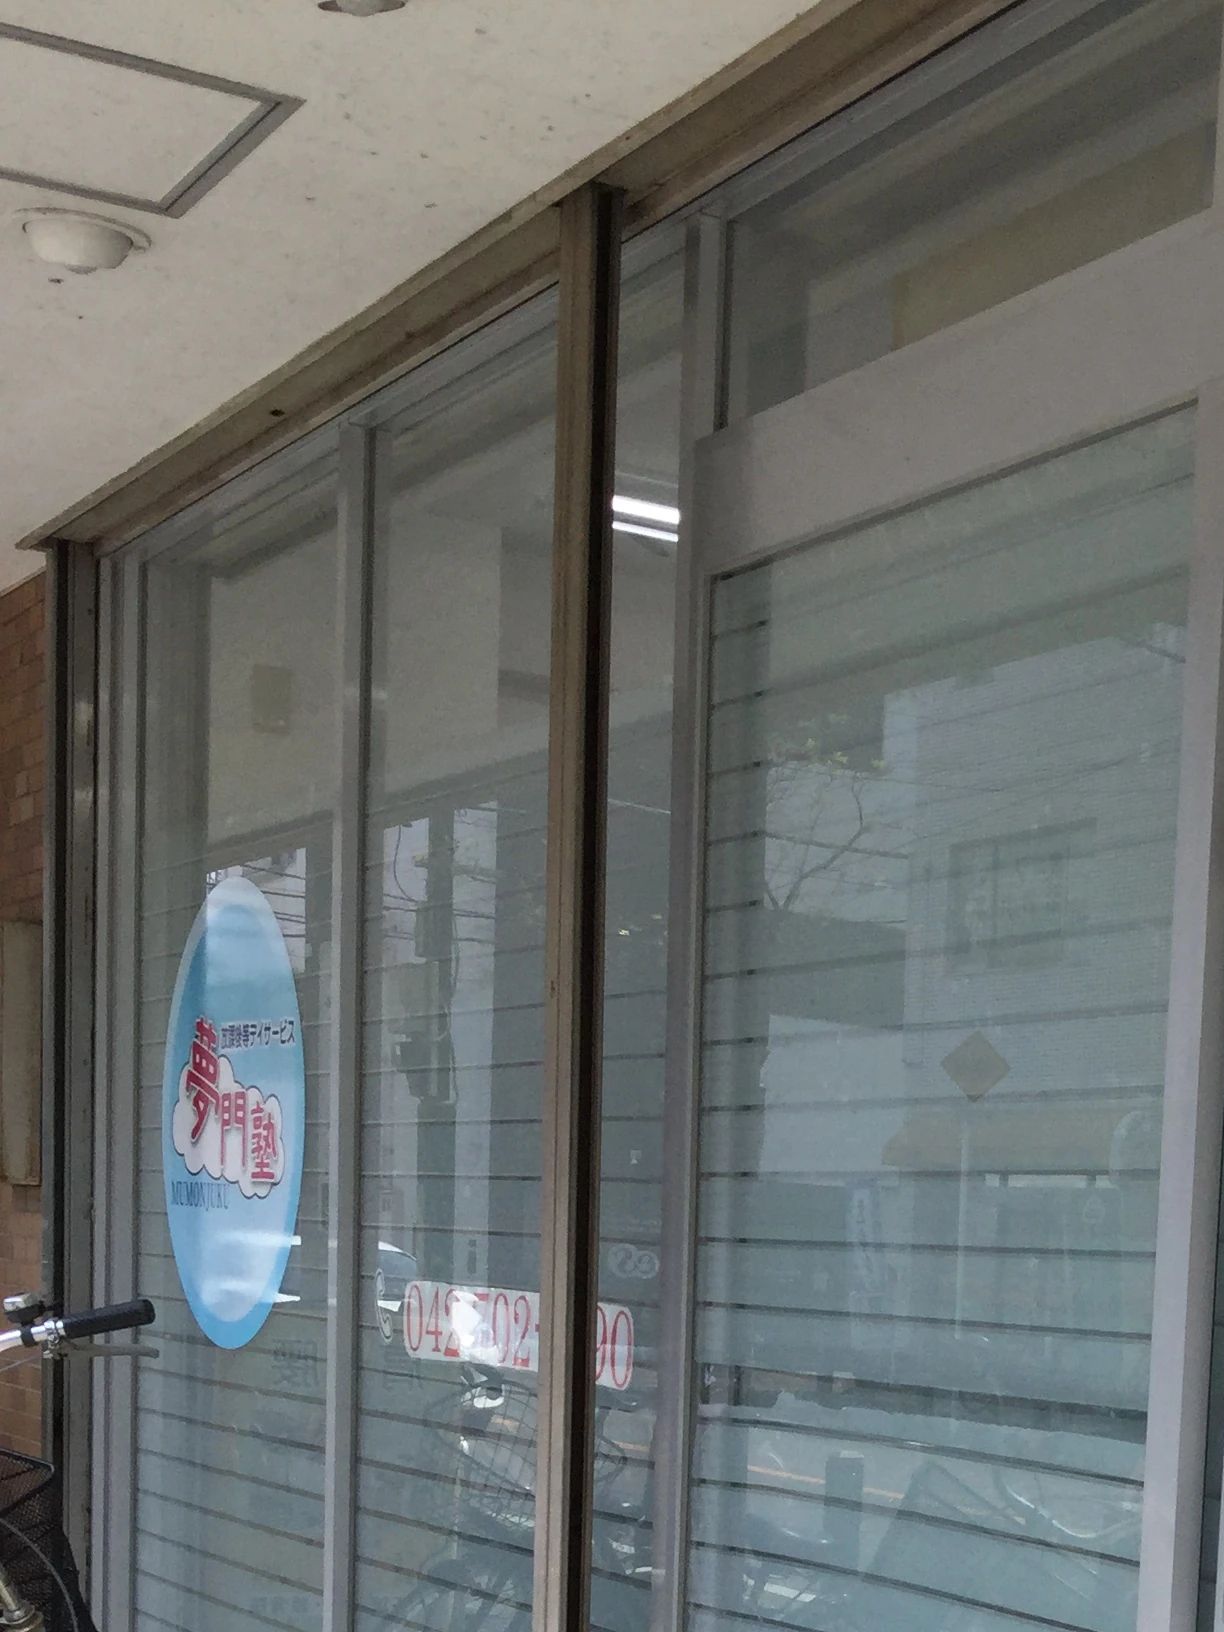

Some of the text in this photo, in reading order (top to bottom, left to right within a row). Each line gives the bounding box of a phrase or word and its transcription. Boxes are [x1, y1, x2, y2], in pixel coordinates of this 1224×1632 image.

[185, 1015, 277, 1181] 夢門塾
[171, 1181, 229, 1212] MUMONJUKU
